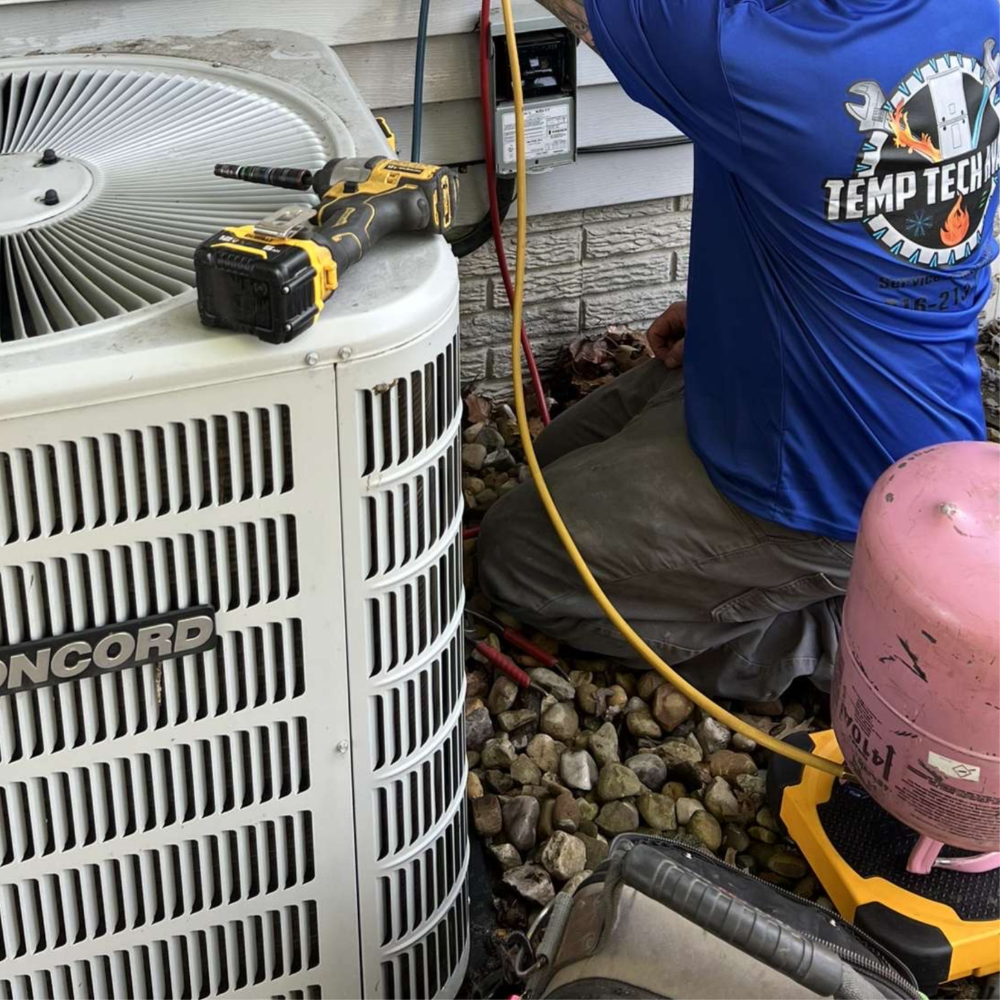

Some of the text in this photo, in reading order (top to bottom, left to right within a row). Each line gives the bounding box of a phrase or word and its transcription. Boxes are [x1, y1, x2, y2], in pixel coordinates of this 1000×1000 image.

[825, 171, 917, 220] TEMP
[923, 151, 983, 205] TECH
[0, 615, 214, 689] NCORD
